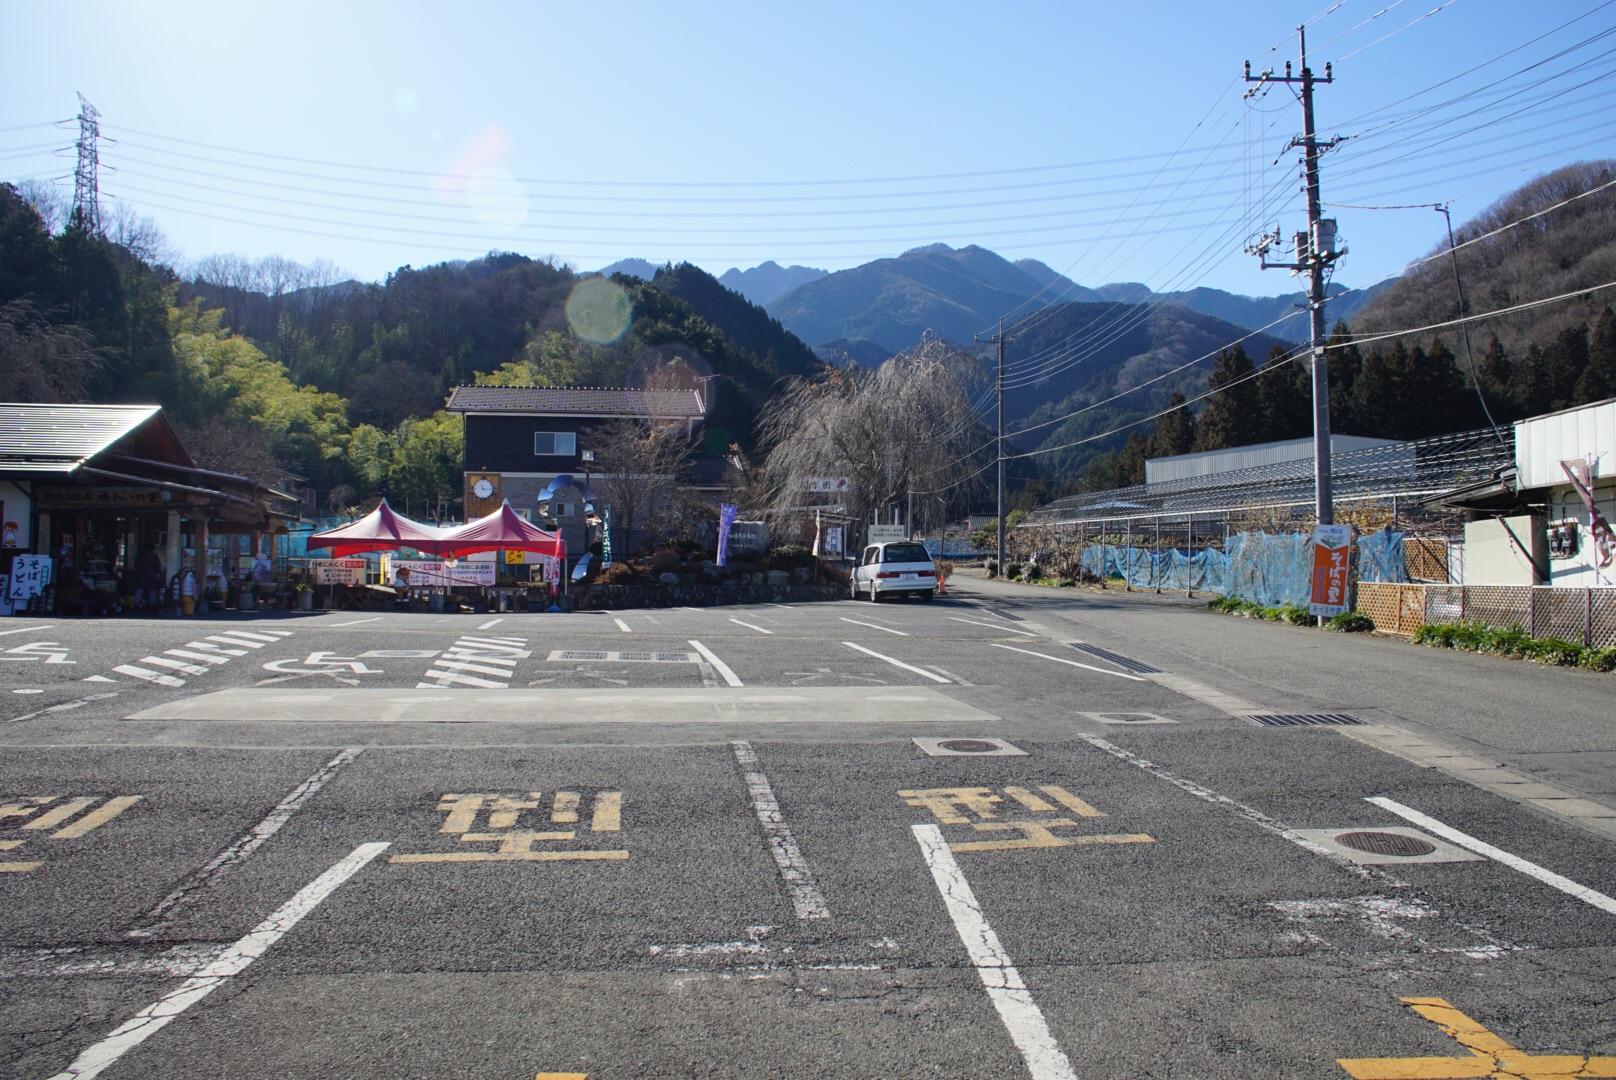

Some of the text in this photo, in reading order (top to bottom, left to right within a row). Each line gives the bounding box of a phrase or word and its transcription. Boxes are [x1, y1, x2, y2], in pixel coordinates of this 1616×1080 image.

[12, 558, 26, 596] うどん
[389, 791, 630, 864] 型
[900, 785, 1155, 852] 型
